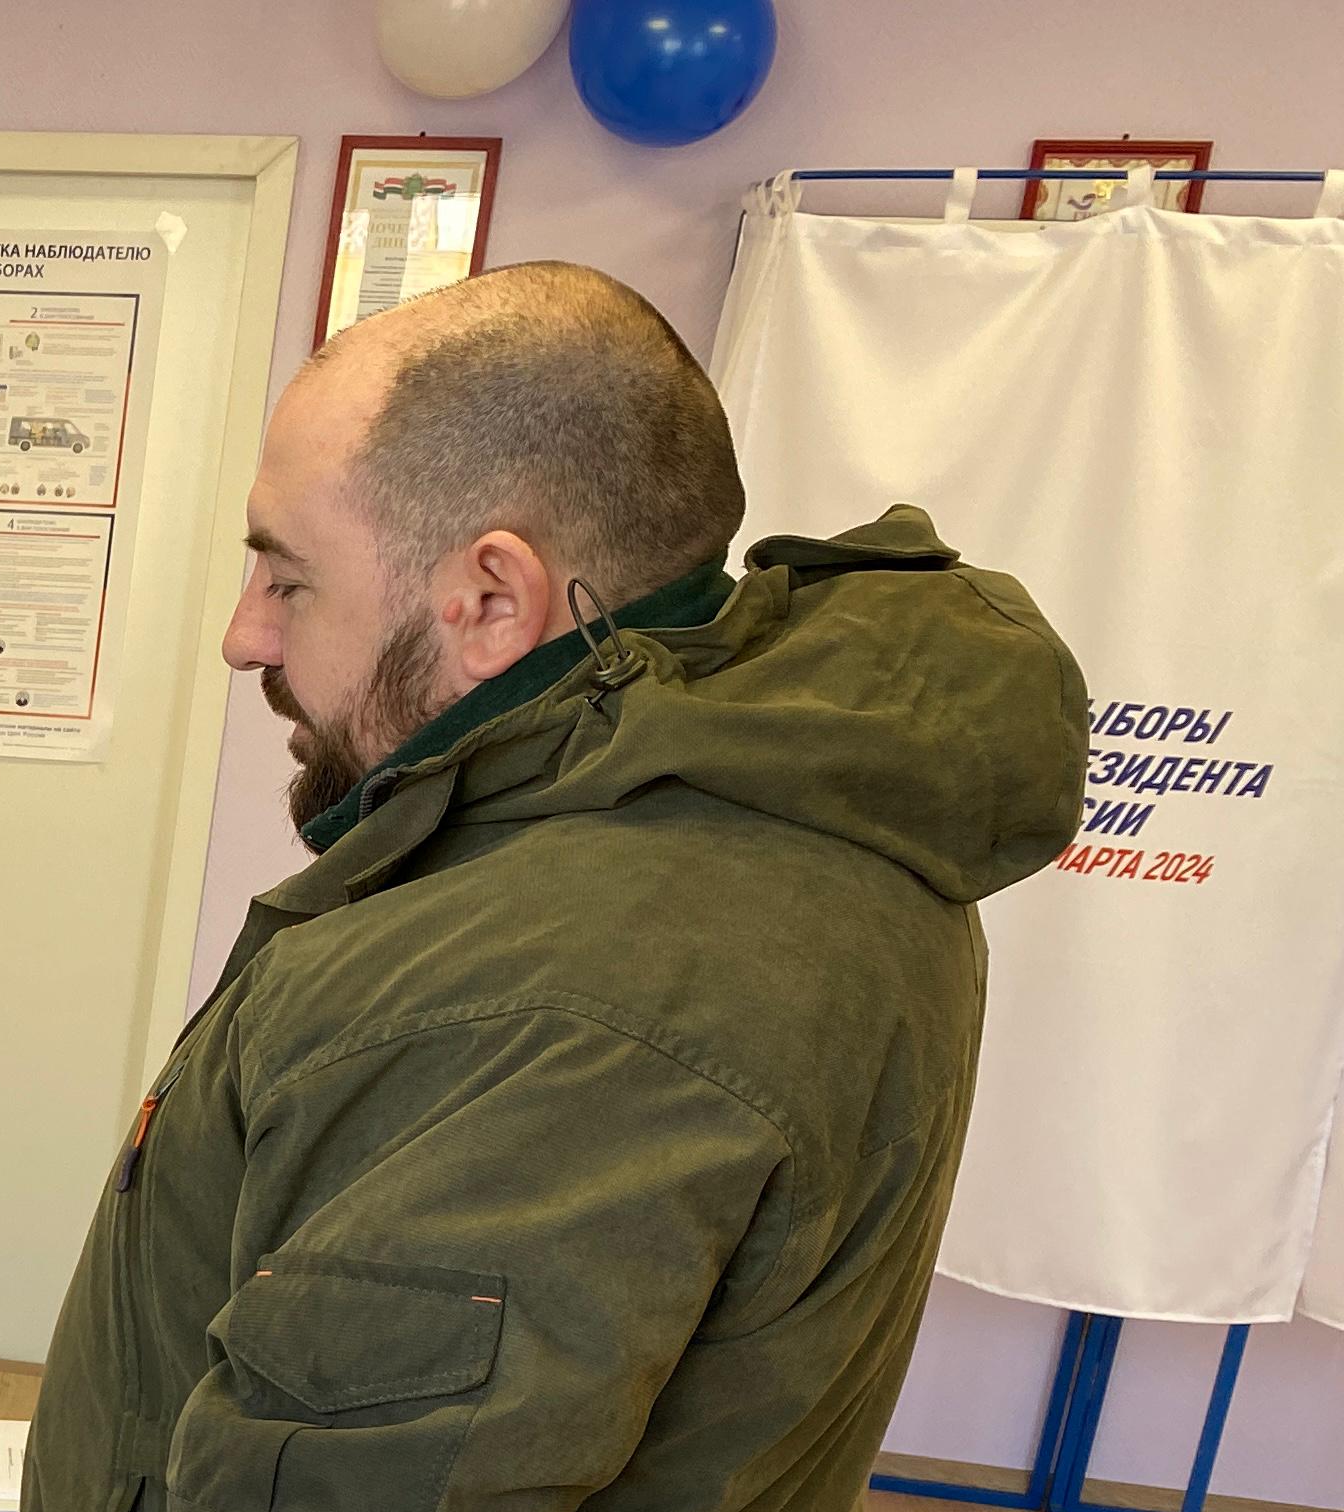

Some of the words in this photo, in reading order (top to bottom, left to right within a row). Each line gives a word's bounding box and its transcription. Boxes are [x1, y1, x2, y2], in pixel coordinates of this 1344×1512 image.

[25, 244, 151, 262] НАБЛЮДАТЕЛЮ
[30, 307, 38, 319] 2
[1143, 851, 1216, 885] 2024
